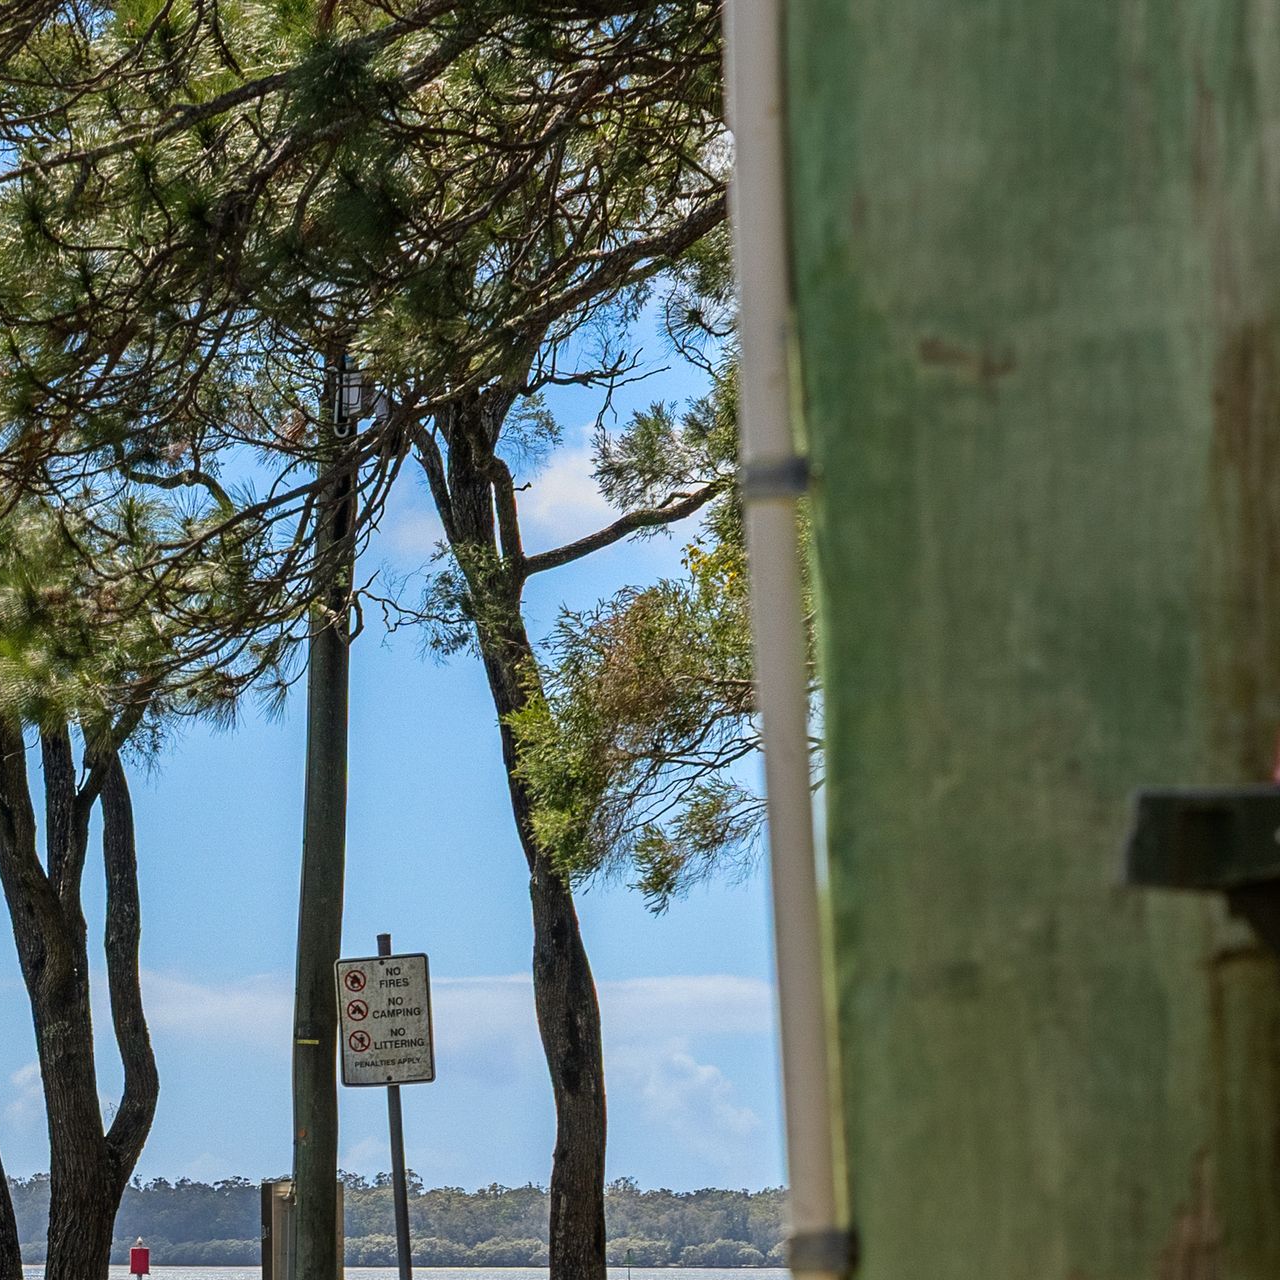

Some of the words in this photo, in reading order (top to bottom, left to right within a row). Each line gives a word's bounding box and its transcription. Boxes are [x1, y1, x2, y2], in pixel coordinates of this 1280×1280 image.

[385, 966, 401, 976] NO
[379, 977, 410, 988] FIRES
[388, 996, 404, 1006] NO
[372, 1007, 421, 1019] CAMPING
[390, 1027, 406, 1037] NO
[374, 1037, 425, 1050] LITTERING
[354, 1059, 396, 1068] PENALTIES
[397, 1057, 421, 1065] APPLY
